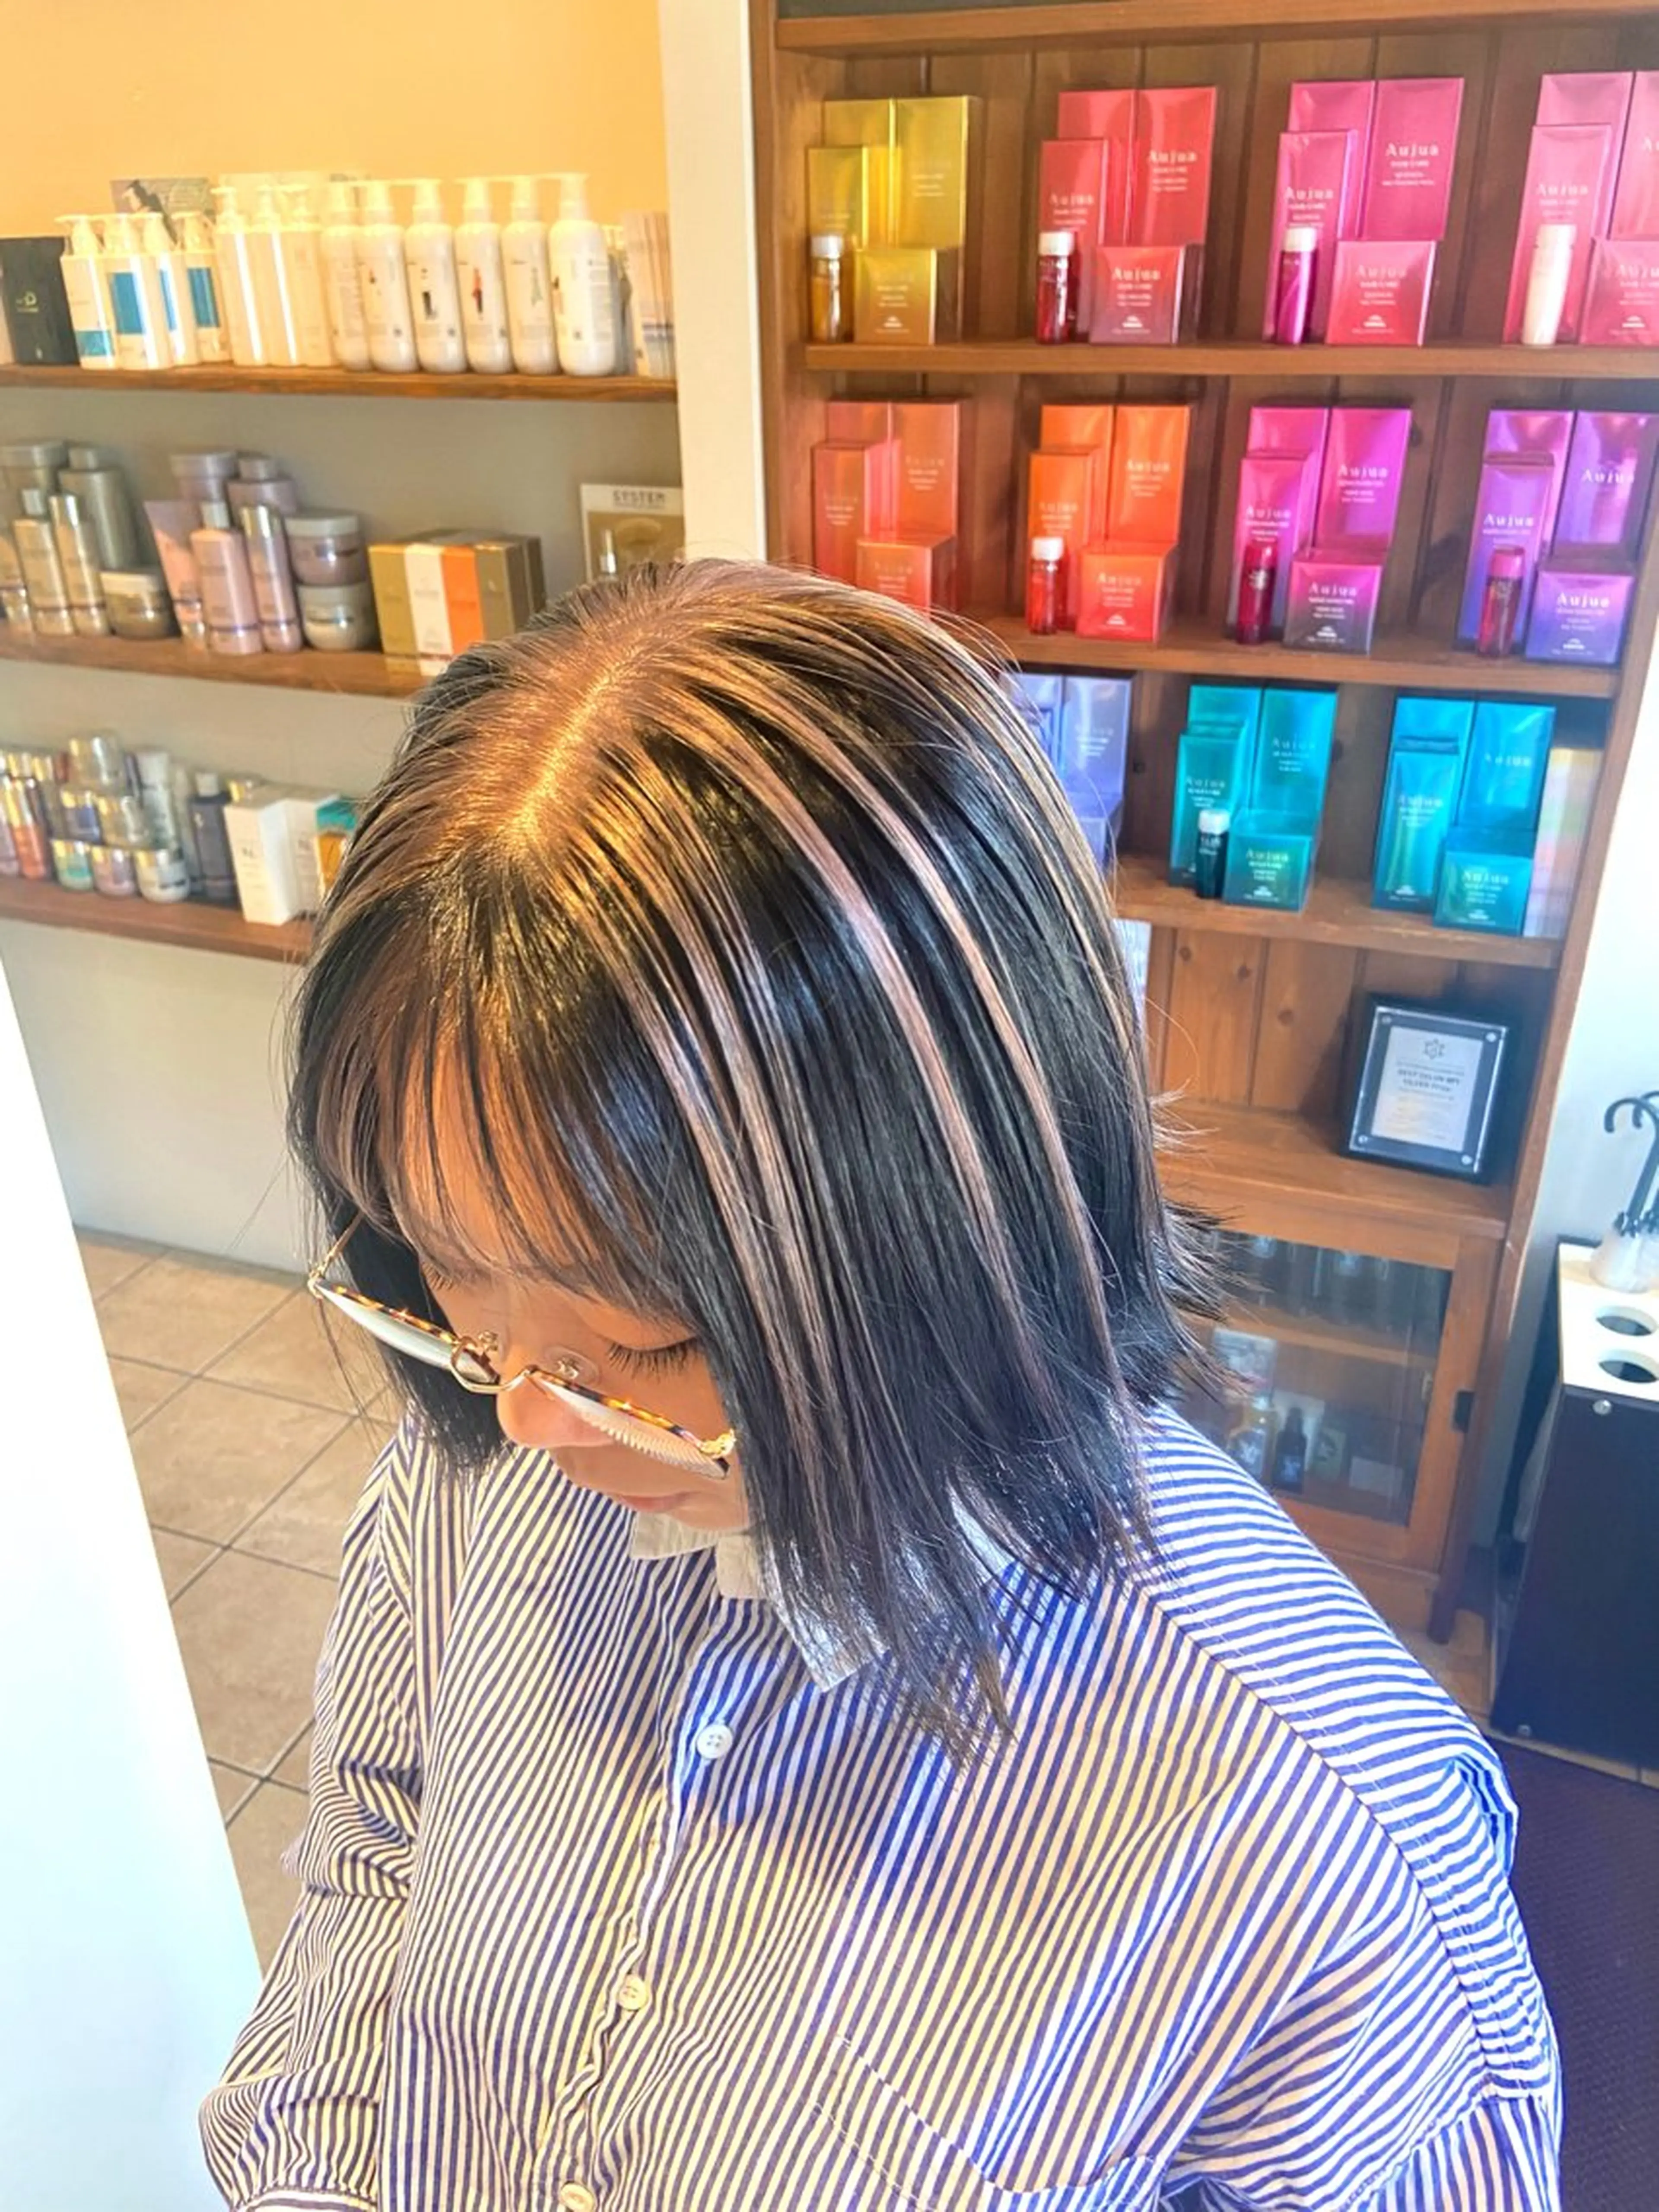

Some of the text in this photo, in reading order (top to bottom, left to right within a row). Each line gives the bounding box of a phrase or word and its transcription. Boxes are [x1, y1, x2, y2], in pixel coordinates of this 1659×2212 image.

[1147, 150, 1197, 164] Aujua
[1385, 143, 1439, 157] Aujua
[1283, 187, 1334, 200] Aujua
[1112, 267, 1160, 282] Aujua
[1338, 464, 1388, 479] Aujua
[1581, 470, 1634, 484] Aujua
[613, 490, 665, 503] SYSTEM
[1246, 506, 1291, 519] Aujua
[1484, 513, 1534, 527] Aujua
[1309, 583, 1357, 597] Aujua
[1557, 592, 1610, 608] Aujua
